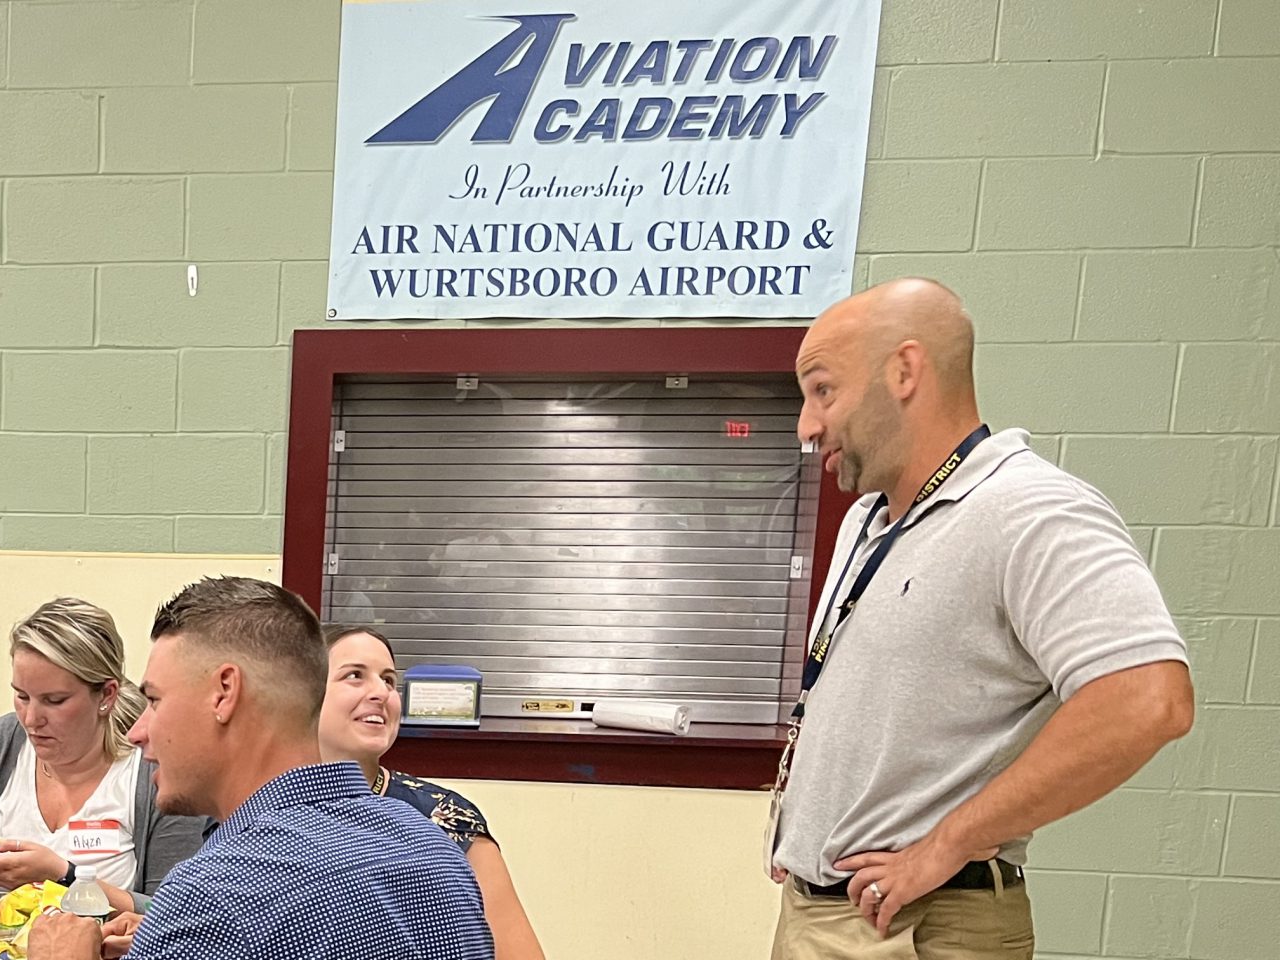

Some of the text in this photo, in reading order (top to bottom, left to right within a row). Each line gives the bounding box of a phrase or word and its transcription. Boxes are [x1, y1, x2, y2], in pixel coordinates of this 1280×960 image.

[448, 160, 731, 206] In Partnership With
[351, 218, 834, 255] AIR NATIONAL GUARD &
[369, 264, 811, 299] WURTSBORO AIRPORT
